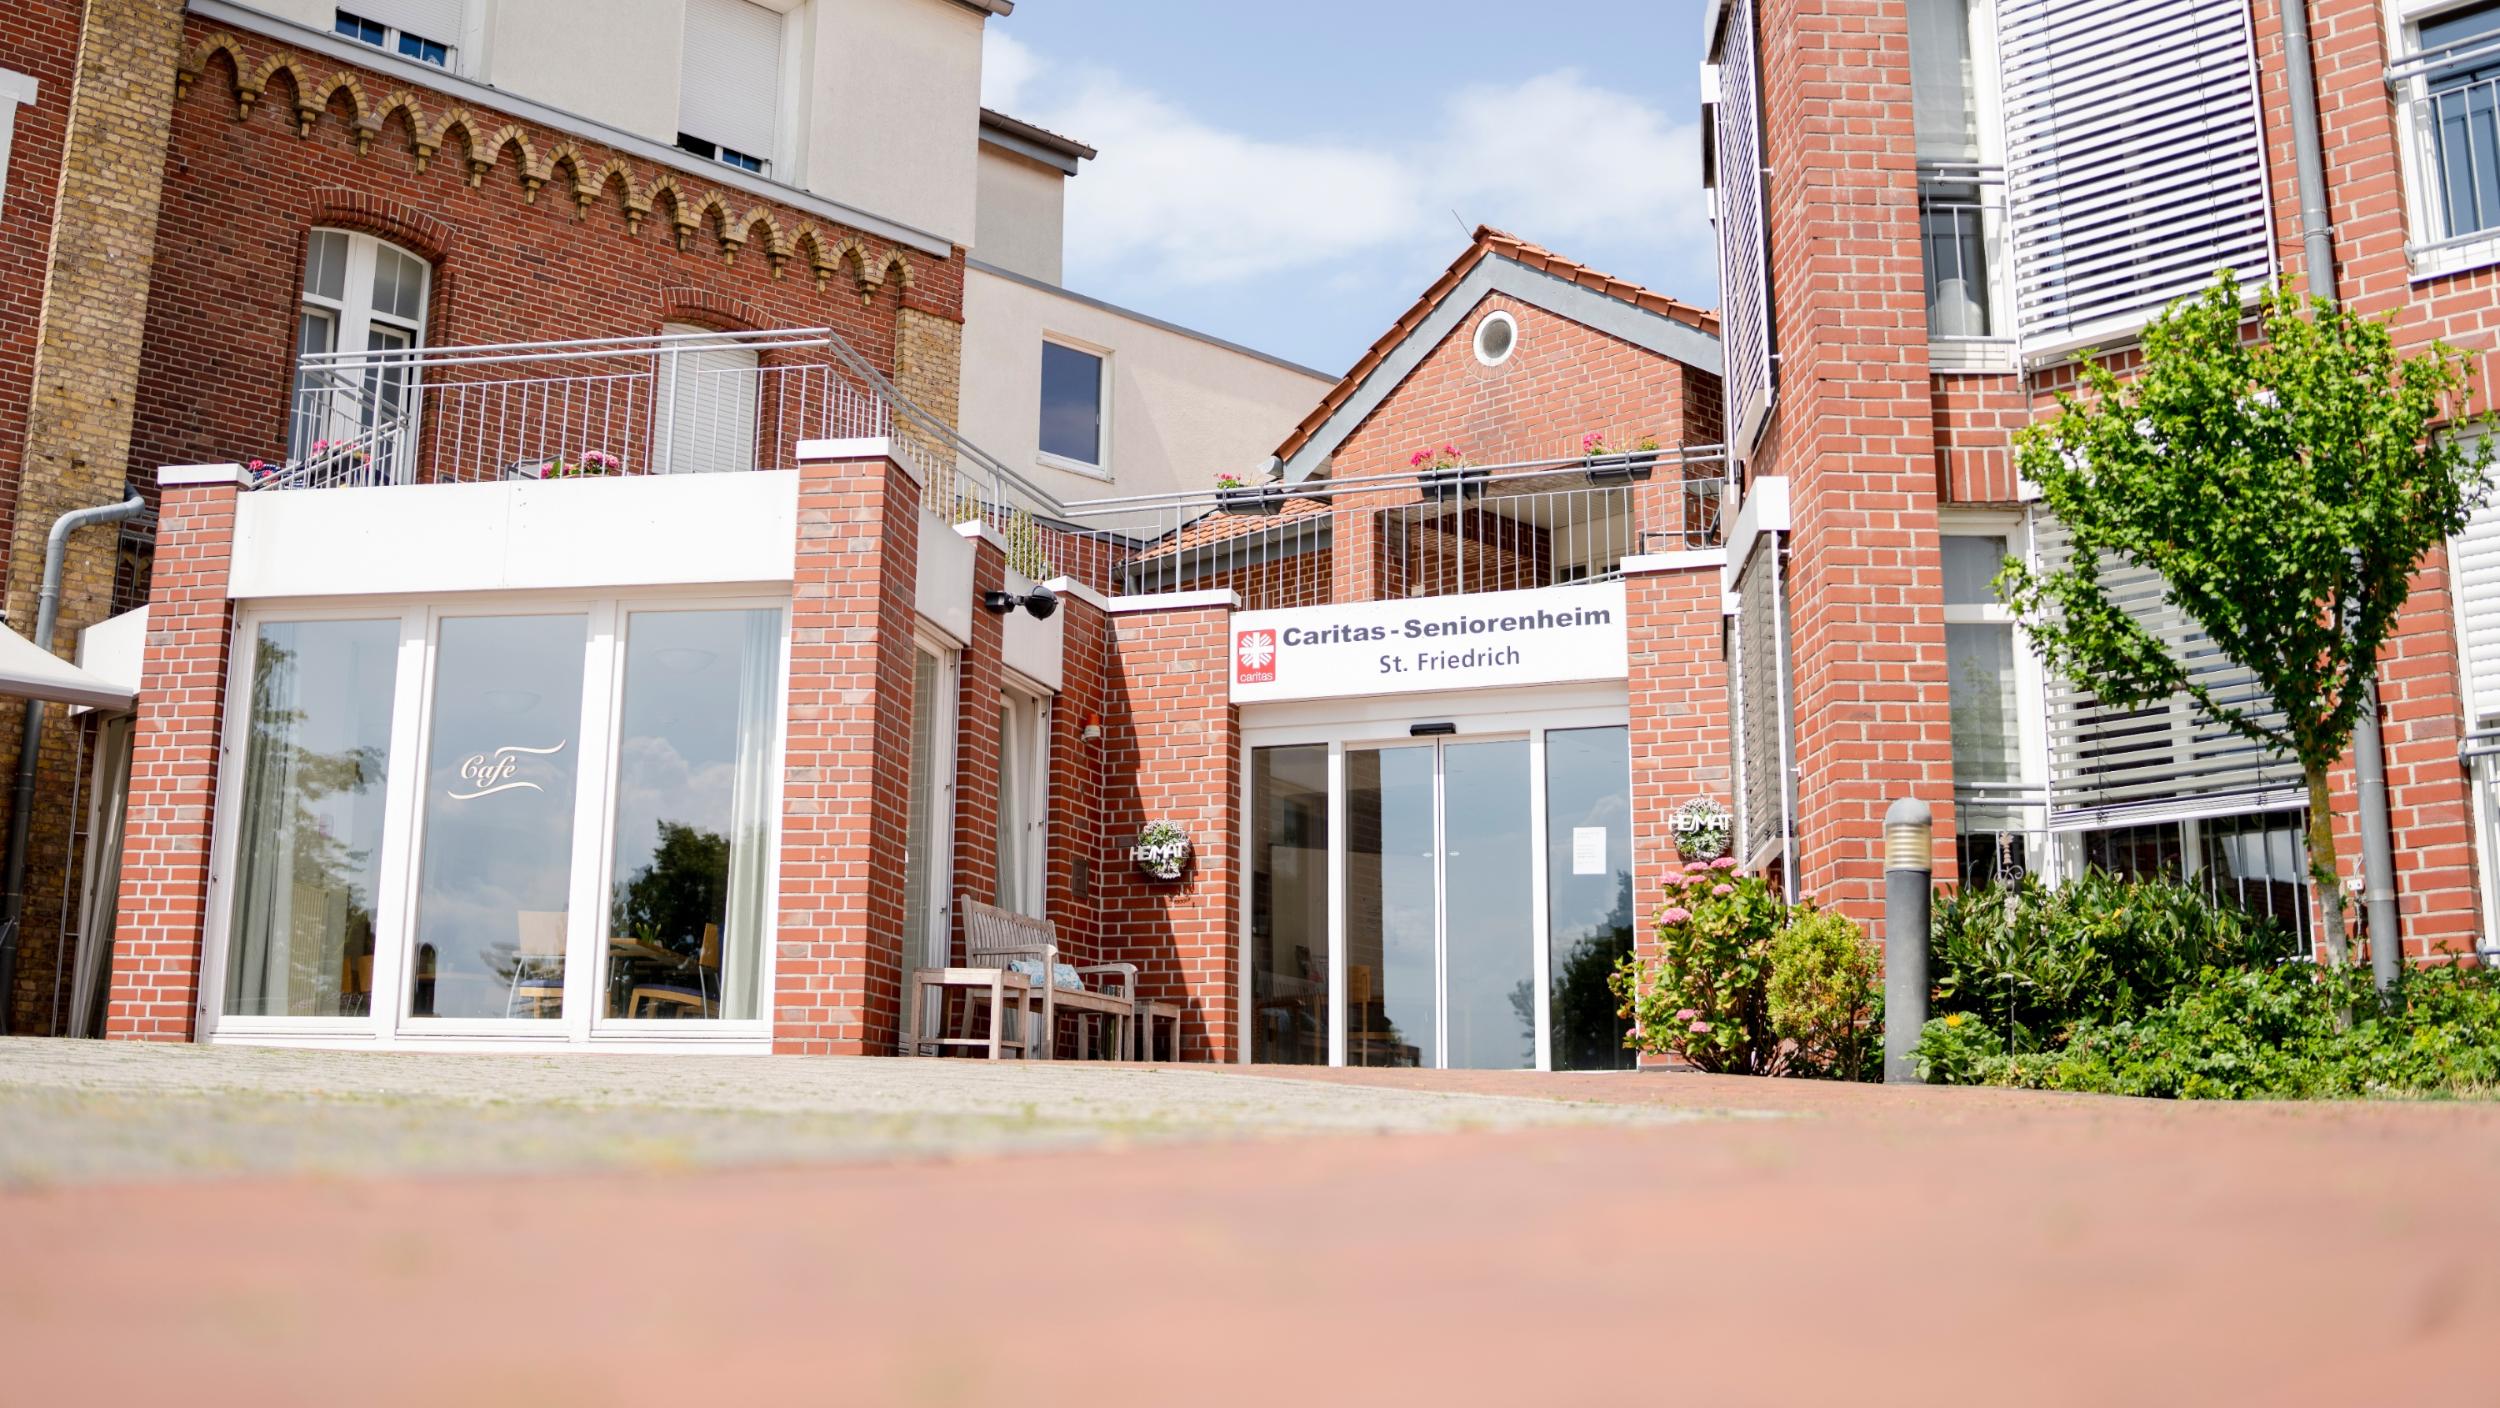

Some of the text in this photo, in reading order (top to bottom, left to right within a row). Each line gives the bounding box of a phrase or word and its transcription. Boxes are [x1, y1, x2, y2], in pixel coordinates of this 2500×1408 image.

[1379, 645, 1520, 674] St. Friedrich
[1240, 671, 1273, 682] caritas
